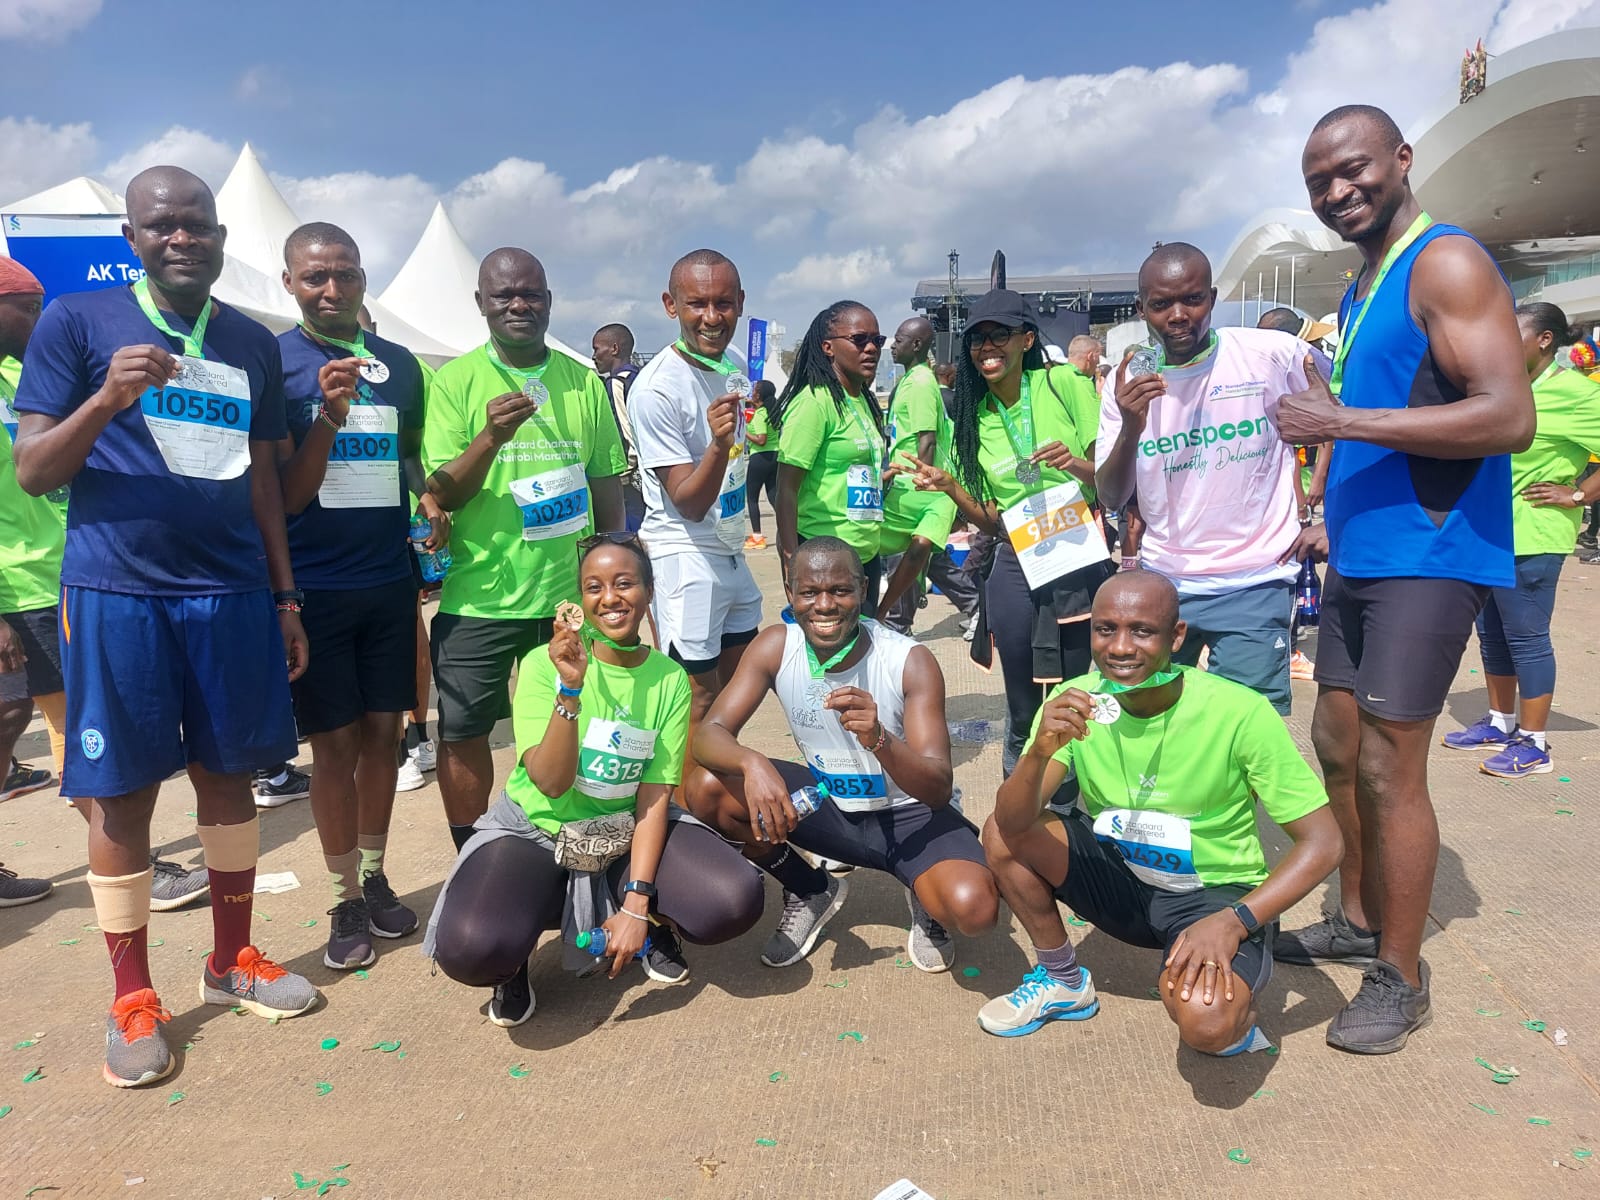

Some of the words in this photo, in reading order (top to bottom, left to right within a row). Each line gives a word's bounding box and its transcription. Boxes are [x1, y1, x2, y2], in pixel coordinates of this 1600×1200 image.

[87, 263, 115, 281] AK
[152, 390, 240, 425] 10550
[500, 440, 536, 451] andard
[1136, 415, 1269, 459] reenspoon
[497, 452, 533, 465] Nairobi
[1162, 449, 1209, 482] Honestly
[531, 494, 584, 524] 10232
[1125, 821, 1163, 831] standard
[1126, 827, 1165, 838] chartered
